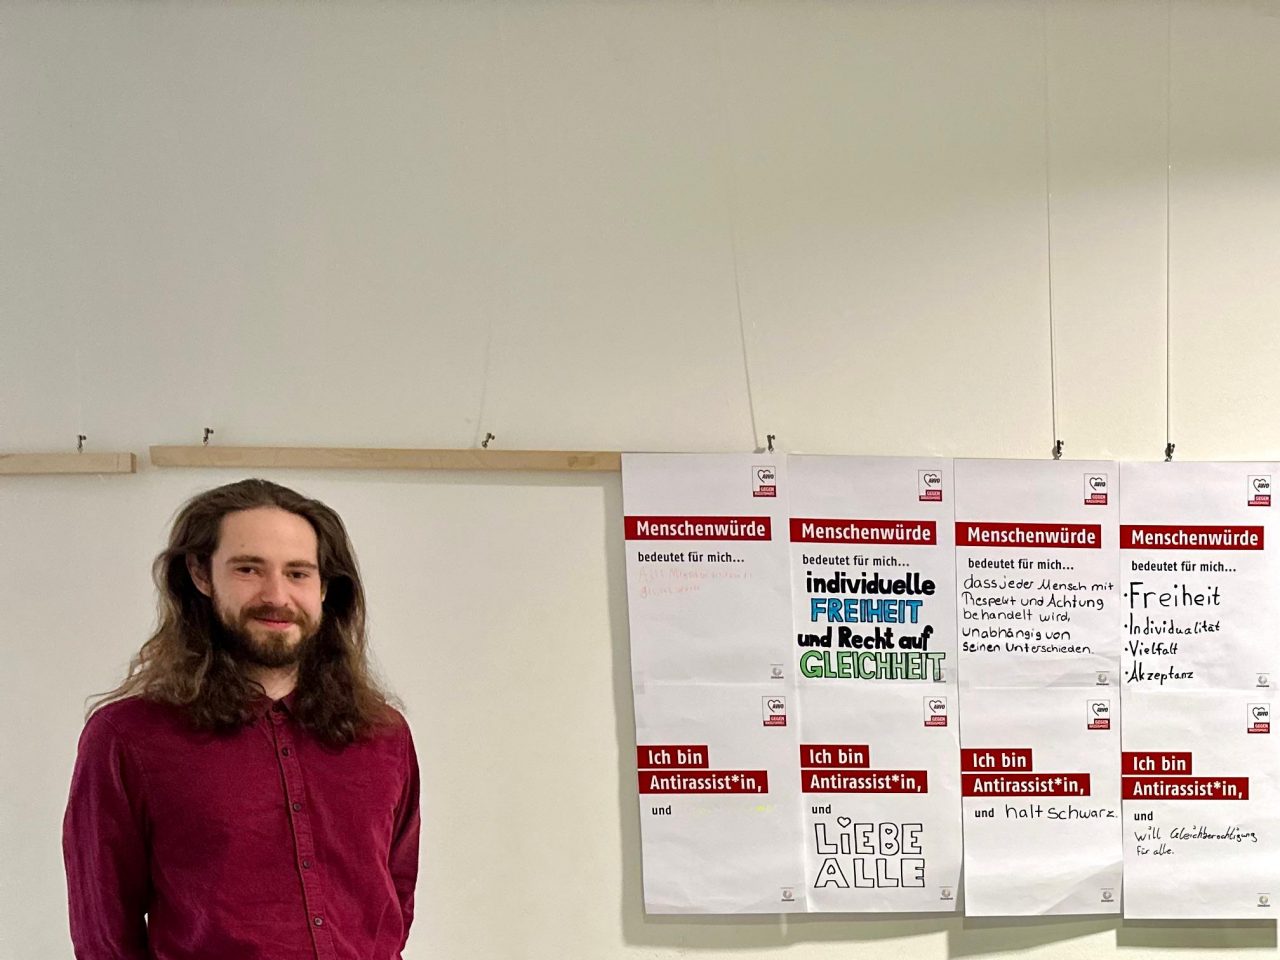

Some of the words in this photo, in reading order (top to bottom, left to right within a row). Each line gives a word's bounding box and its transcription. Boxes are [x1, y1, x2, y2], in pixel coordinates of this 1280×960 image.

[636, 520, 766, 537] Menschenwürde
[802, 522, 931, 541] Menschenwürde
[967, 527, 1096, 544] Menschenwürde
[1131, 530, 1258, 546] Menschenwürde
[638, 552, 685, 562] bedeutet
[688, 551, 704, 562] für
[802, 554, 850, 566] bedeutet
[853, 554, 869, 566] für
[968, 558, 1015, 569] bedeutet
[1018, 558, 1034, 569] für
[1131, 561, 1178, 572] bedeutet
[1180, 561, 1197, 572] für
[806, 571, 936, 595] individuelle
[998, 575, 1034, 591] jeder
[1037, 579, 1087, 591] Mensch
[1091, 582, 1114, 591] mit
[1021, 595, 1044, 607] und
[1047, 596, 1104, 610] Achtung
[1129, 582, 1222, 609] Freiheit
[810, 598, 923, 624] FREIHEIT
[963, 608, 1032, 621] behandelt
[1129, 613, 1220, 635] Individualität
[798, 627, 831, 647] und
[838, 626, 895, 649] Recht
[899, 624, 934, 651] auf
[962, 626, 1042, 641] unabhängig
[1045, 630, 1071, 640] von
[1128, 639, 1178, 656] Vielfalt
[800, 650, 946, 681] GLEICHHEIT
[1128, 659, 1194, 685] Akzeptanz
[648, 750, 671, 764] Ich
[677, 749, 703, 764] bin
[810, 749, 832, 763] Ich
[838, 749, 864, 763] bin
[973, 753, 995, 768] Ich
[1001, 753, 1026, 768] bin
[1133, 756, 1155, 771] Ich
[1161, 756, 1186, 771] bin
[652, 805, 672, 815] und
[812, 804, 831, 814] und
[974, 808, 994, 818] und
[1005, 804, 1044, 819] halt
[1134, 811, 1153, 821] und
[814, 858, 926, 888] ALLE
